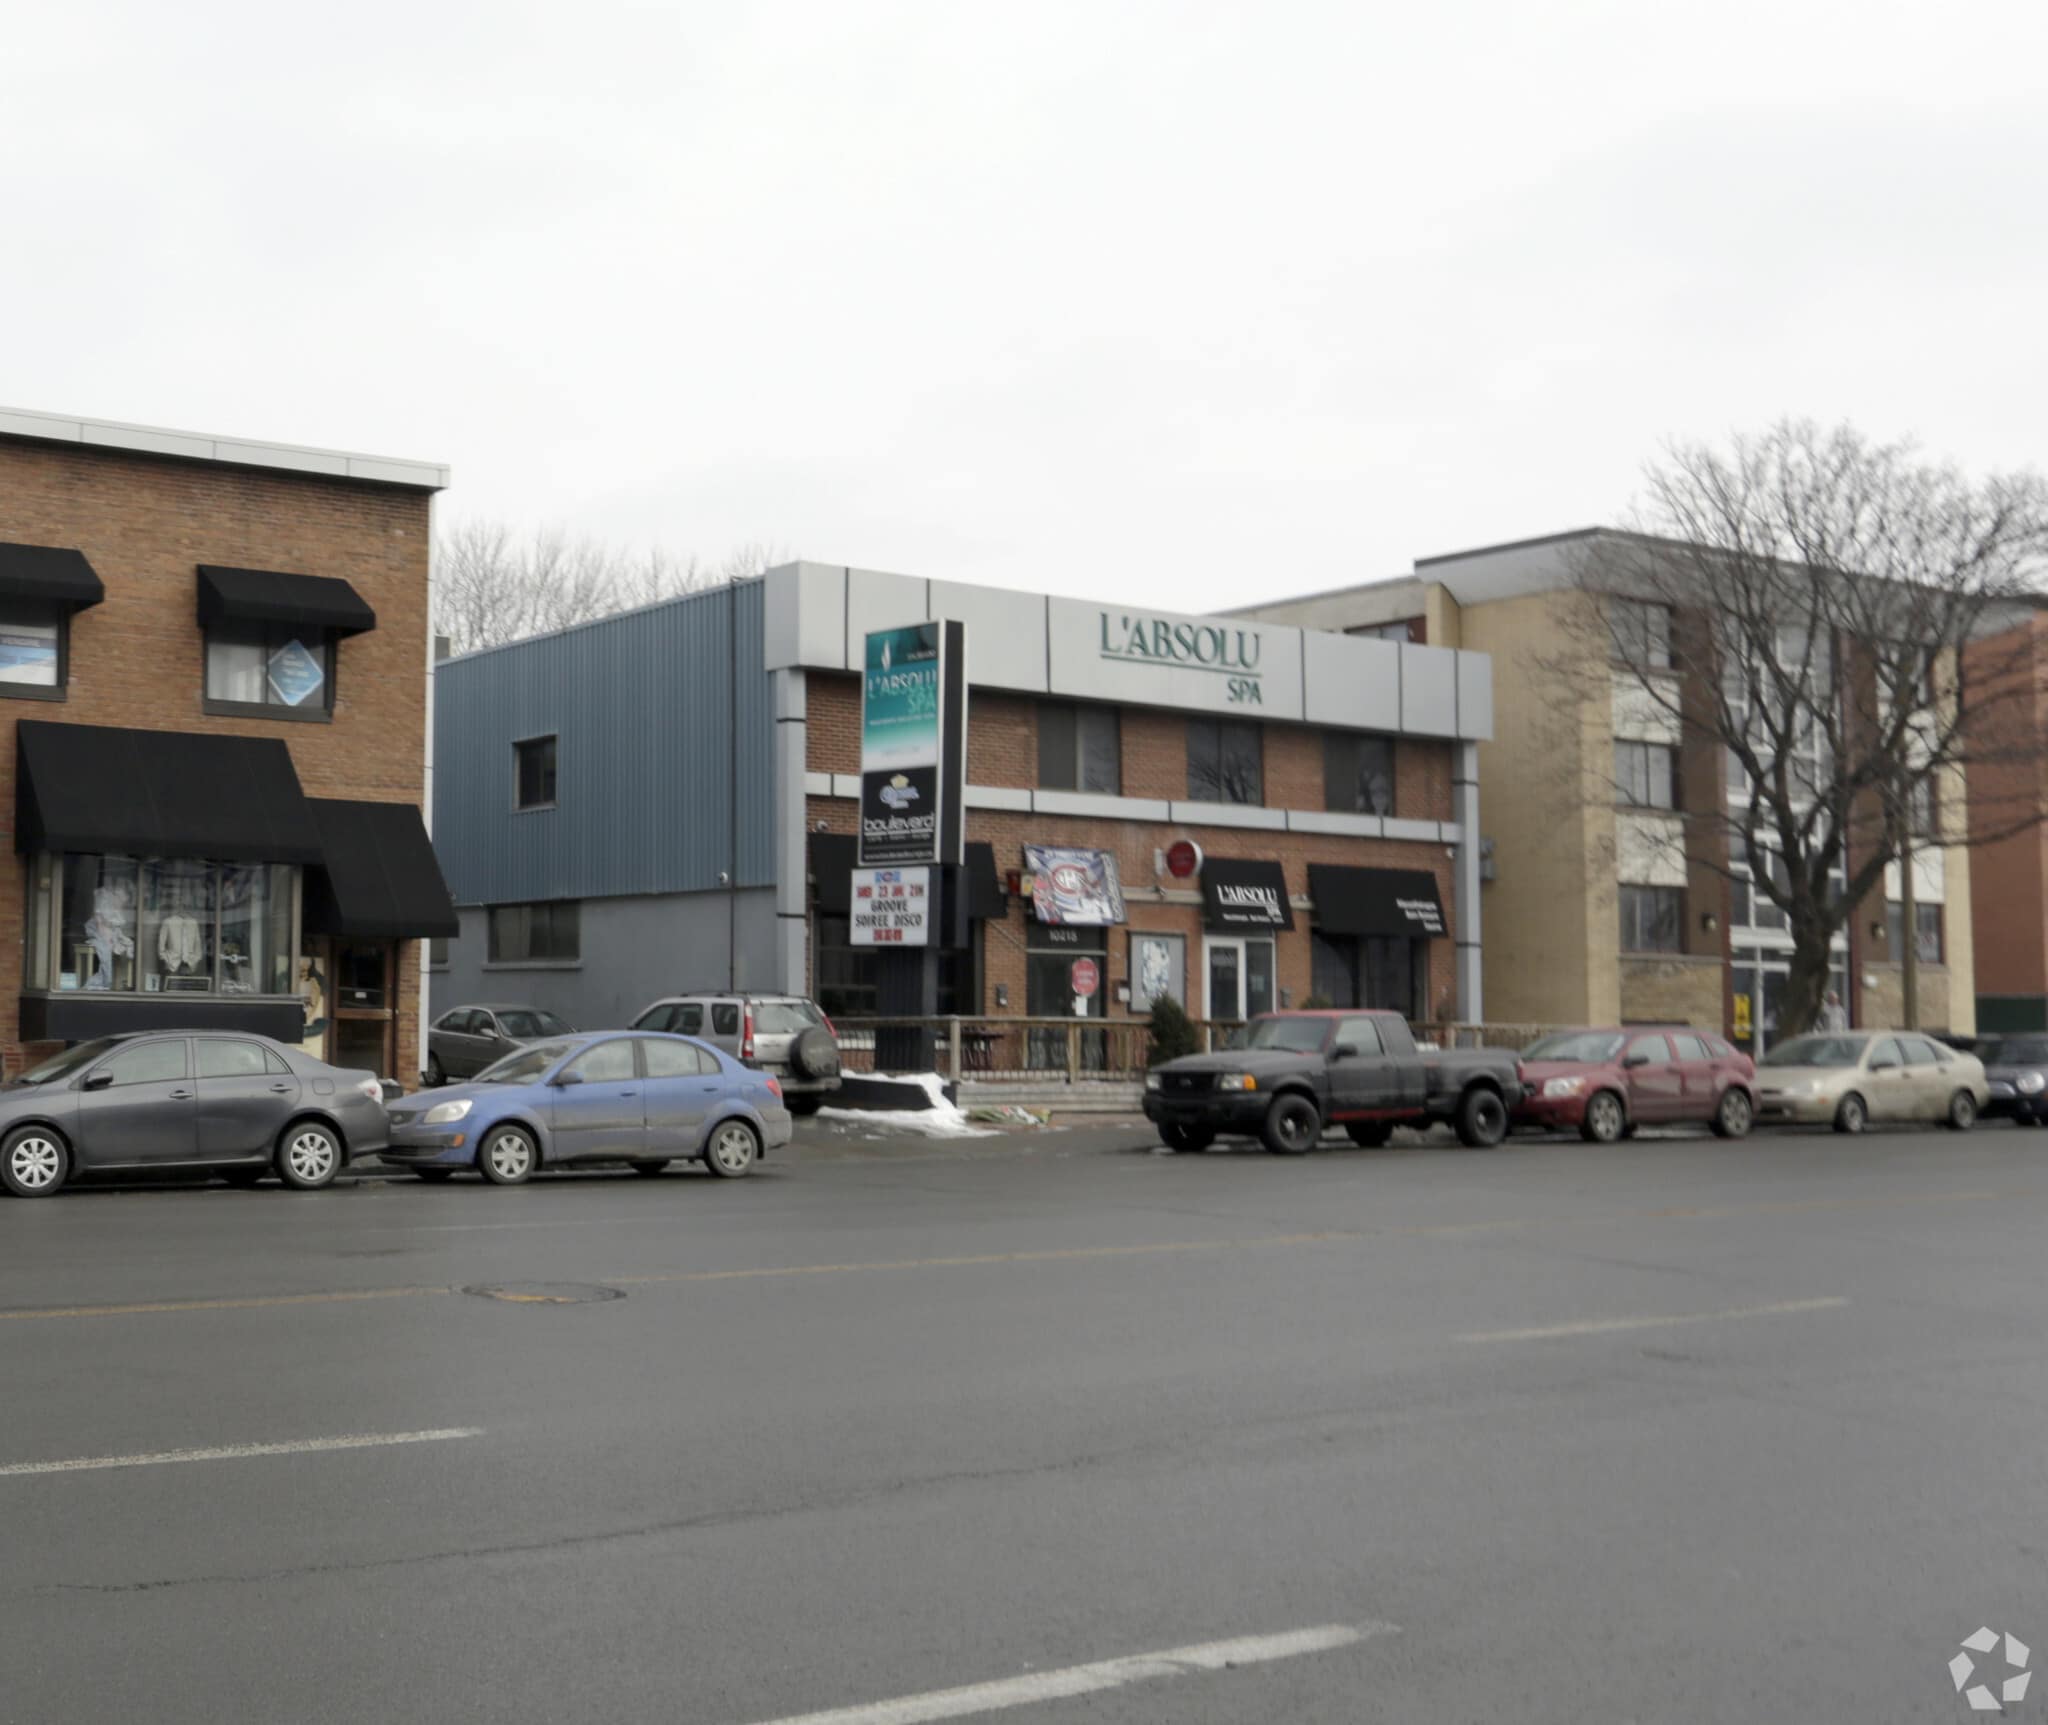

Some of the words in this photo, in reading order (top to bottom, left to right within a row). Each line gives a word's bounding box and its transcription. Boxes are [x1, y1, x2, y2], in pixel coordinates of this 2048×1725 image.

[1100, 612, 1261, 669] L'ABSOLU
[868, 668, 937, 700] L'ABSOLU
[1227, 678, 1262, 704] SPA
[1216, 884, 1278, 906] L'ABSOLU
[855, 913, 889, 927] SOIREE
[894, 913, 922, 927] DISCO
